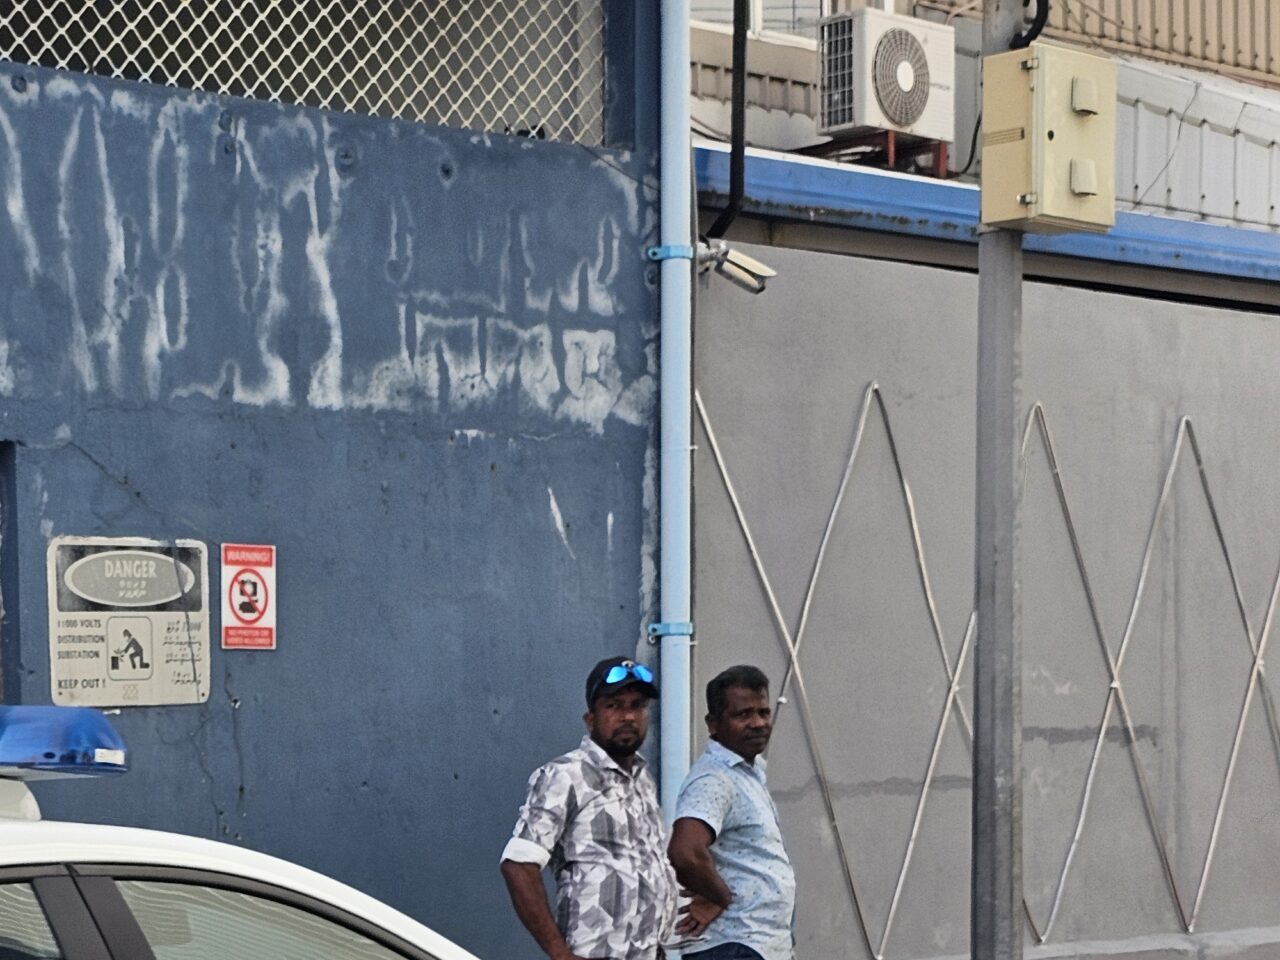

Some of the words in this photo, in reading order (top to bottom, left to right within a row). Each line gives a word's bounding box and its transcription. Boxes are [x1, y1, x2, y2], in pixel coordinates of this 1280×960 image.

[104, 559, 157, 578] DANGER
[80, 619, 102, 628] VOLTS
[57, 634, 105, 644] DISTRIBUTION
[57, 650, 100, 660] SUBSTATION
[57, 680, 79, 689] KEEP
[81, 679, 100, 688] OUT
